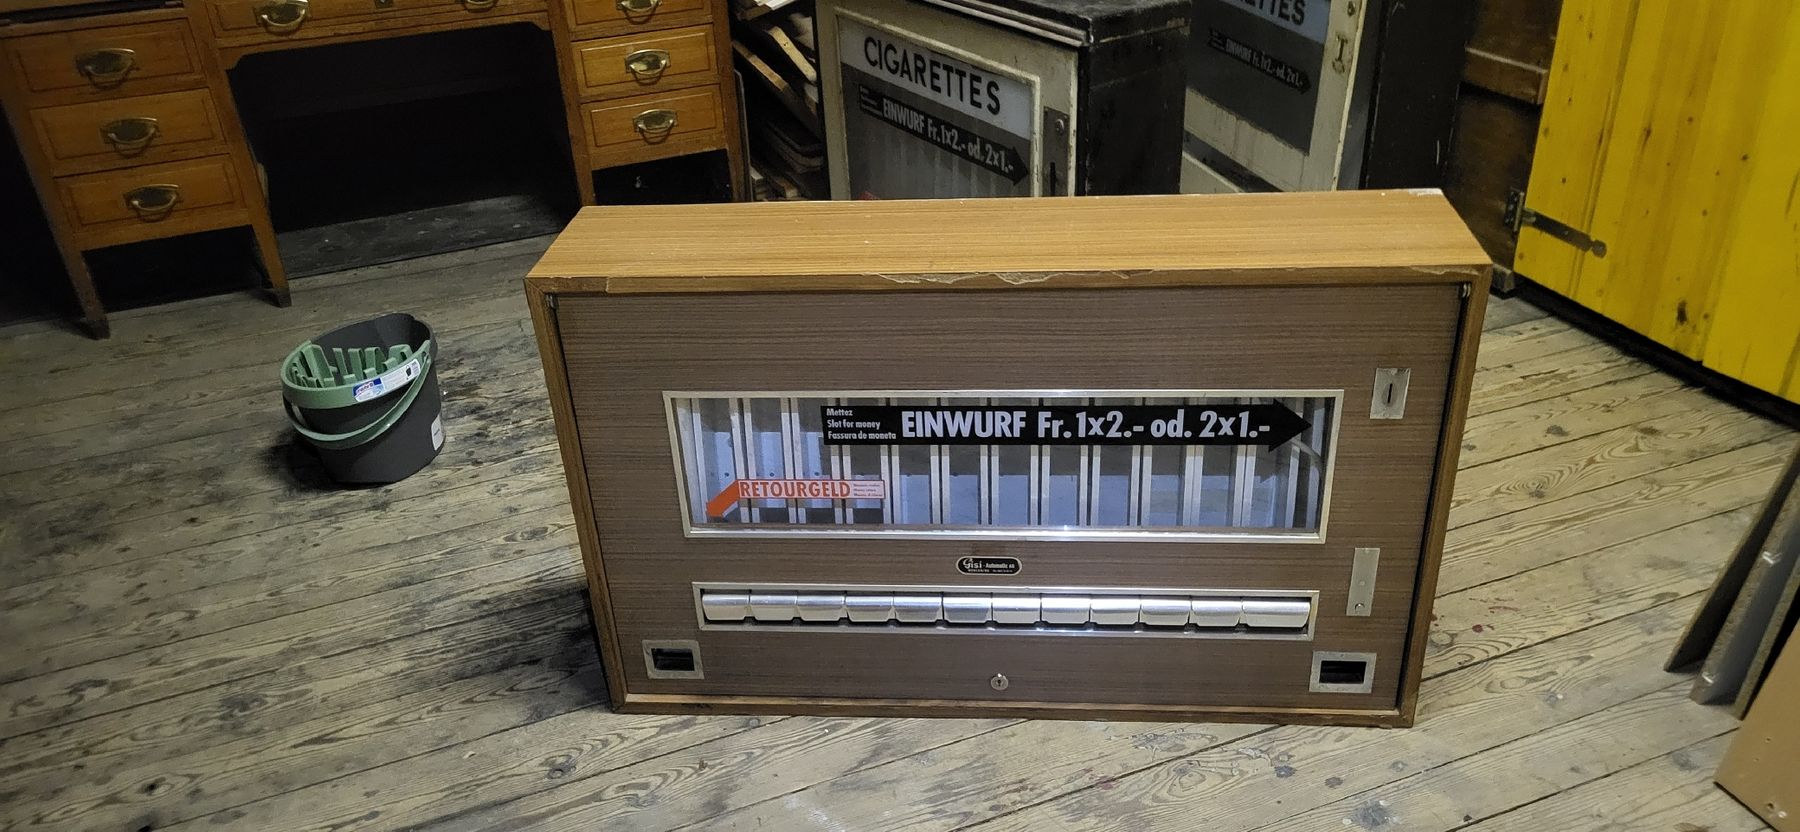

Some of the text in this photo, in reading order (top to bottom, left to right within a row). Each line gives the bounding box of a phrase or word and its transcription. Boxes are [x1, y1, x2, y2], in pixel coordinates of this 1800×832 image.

[864, 36, 1001, 116] CIGARETTES
[882, 97, 925, 132] EINWURF
[826, 408, 853, 417] Mettez
[827, 419, 881, 431] Slot for money
[901, 411, 1027, 438] EINWURF
[1037, 411, 1072, 438] Fr.
[1150, 409, 1192, 438] od.
[1199, 410, 1271, 438] 2x1.-
[858, 430, 868, 440] de
[868, 431, 897, 440] moneta
[739, 481, 851, 497] RETOURGELD
